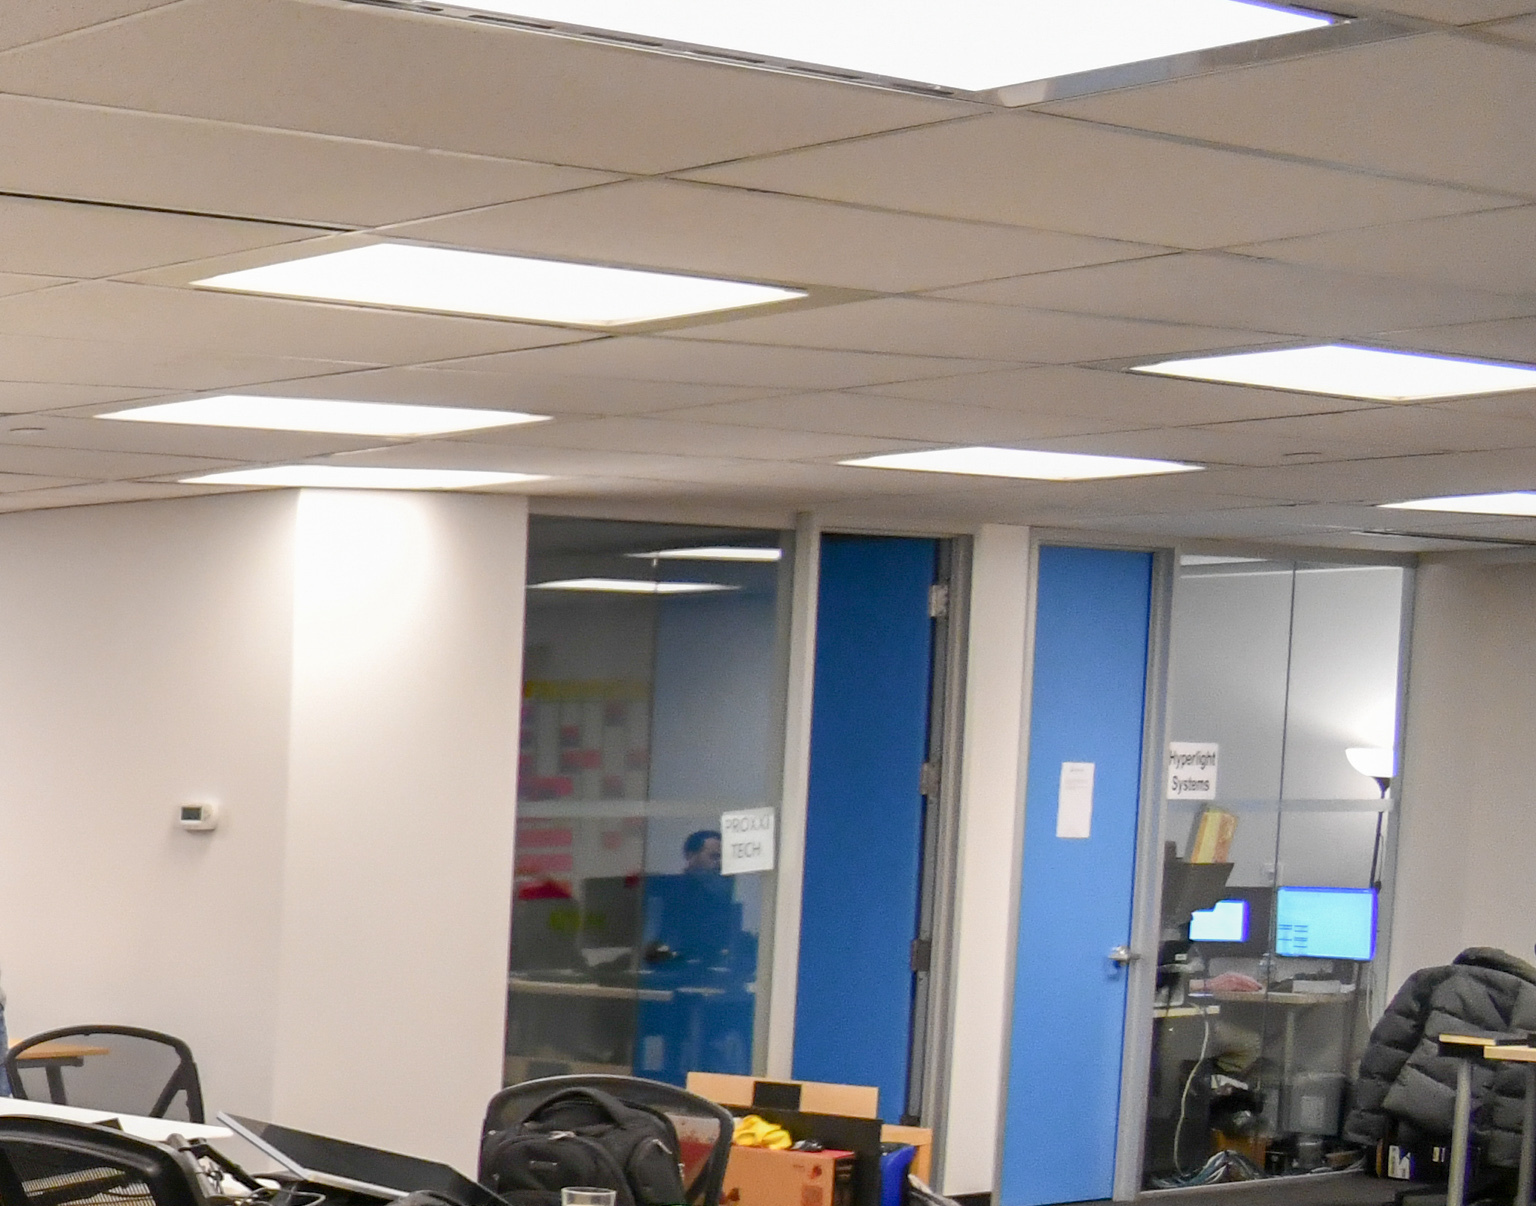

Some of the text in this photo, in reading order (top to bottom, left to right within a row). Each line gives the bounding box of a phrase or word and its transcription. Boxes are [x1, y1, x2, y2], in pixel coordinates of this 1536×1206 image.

[1168, 751, 1216, 770] Hyperlight
[1172, 776, 1210, 795] Systems
[731, 841, 761, 859] TECH
